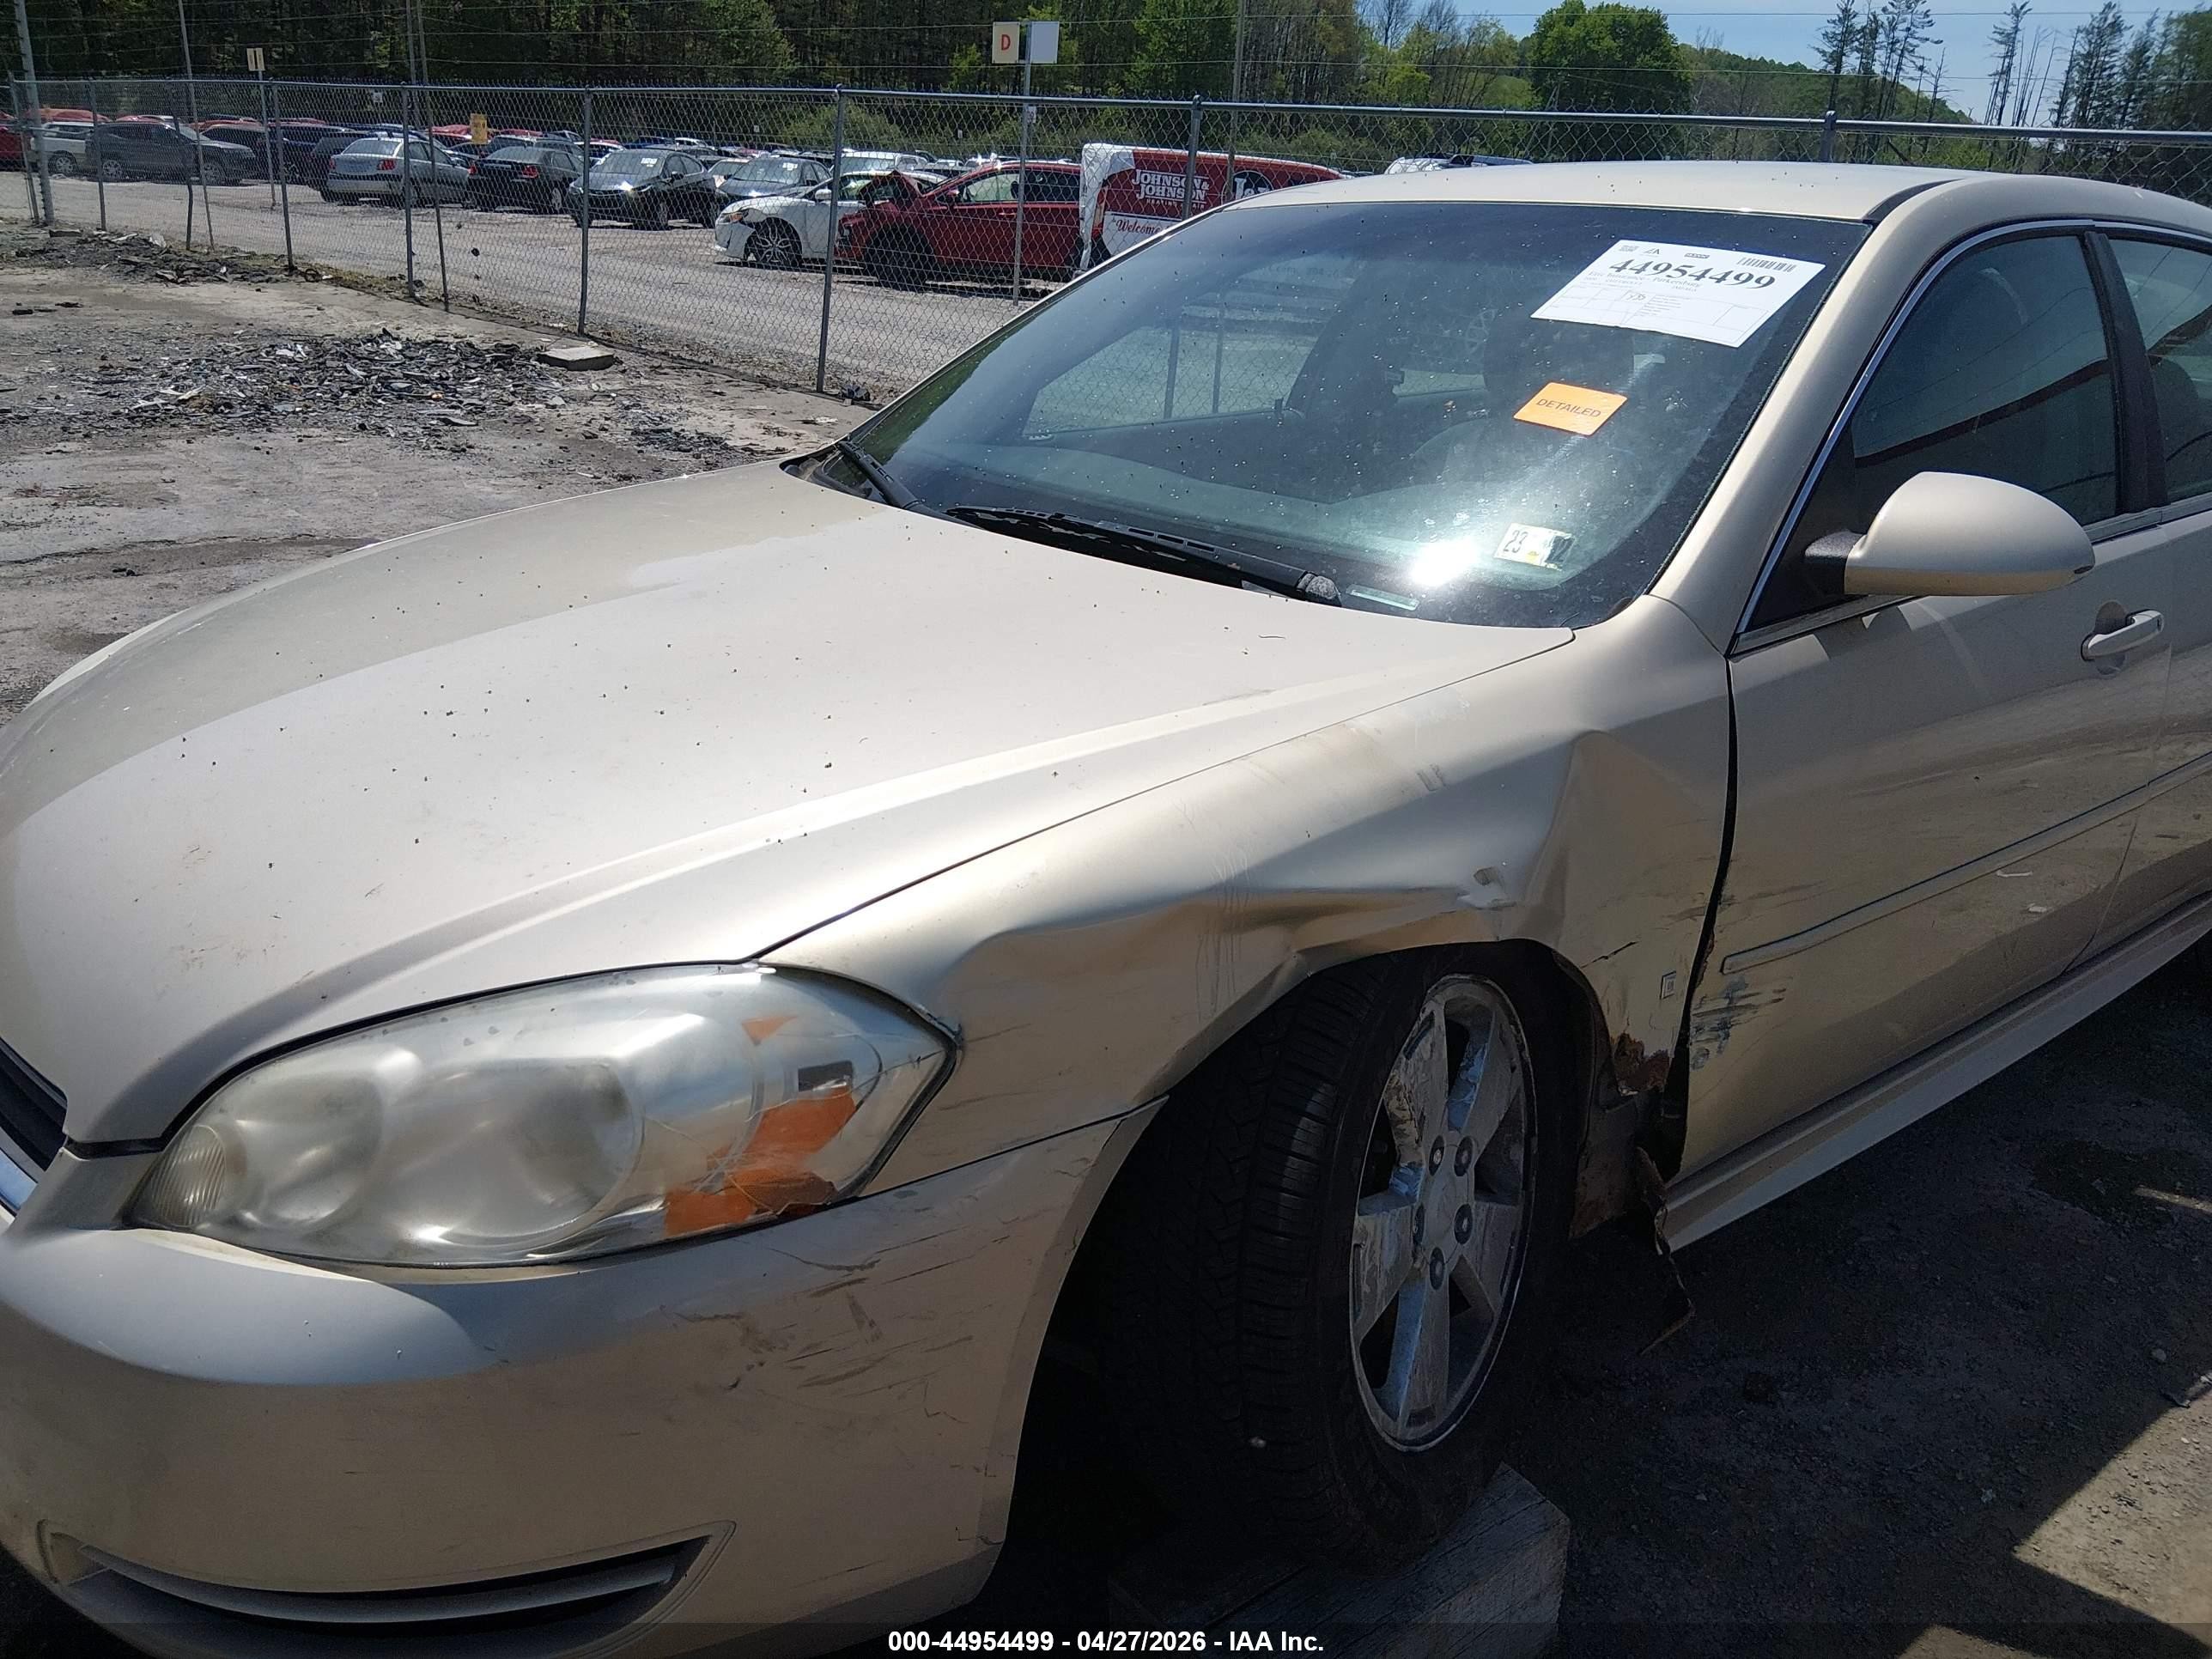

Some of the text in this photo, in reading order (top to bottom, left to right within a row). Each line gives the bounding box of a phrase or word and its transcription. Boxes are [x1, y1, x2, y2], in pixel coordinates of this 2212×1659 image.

[1001, 34, 1011, 51] D
[1609, 258, 1776, 289] 44954499
[1536, 398, 1601, 417] DETAILED
[1503, 530, 1528, 554] 23
